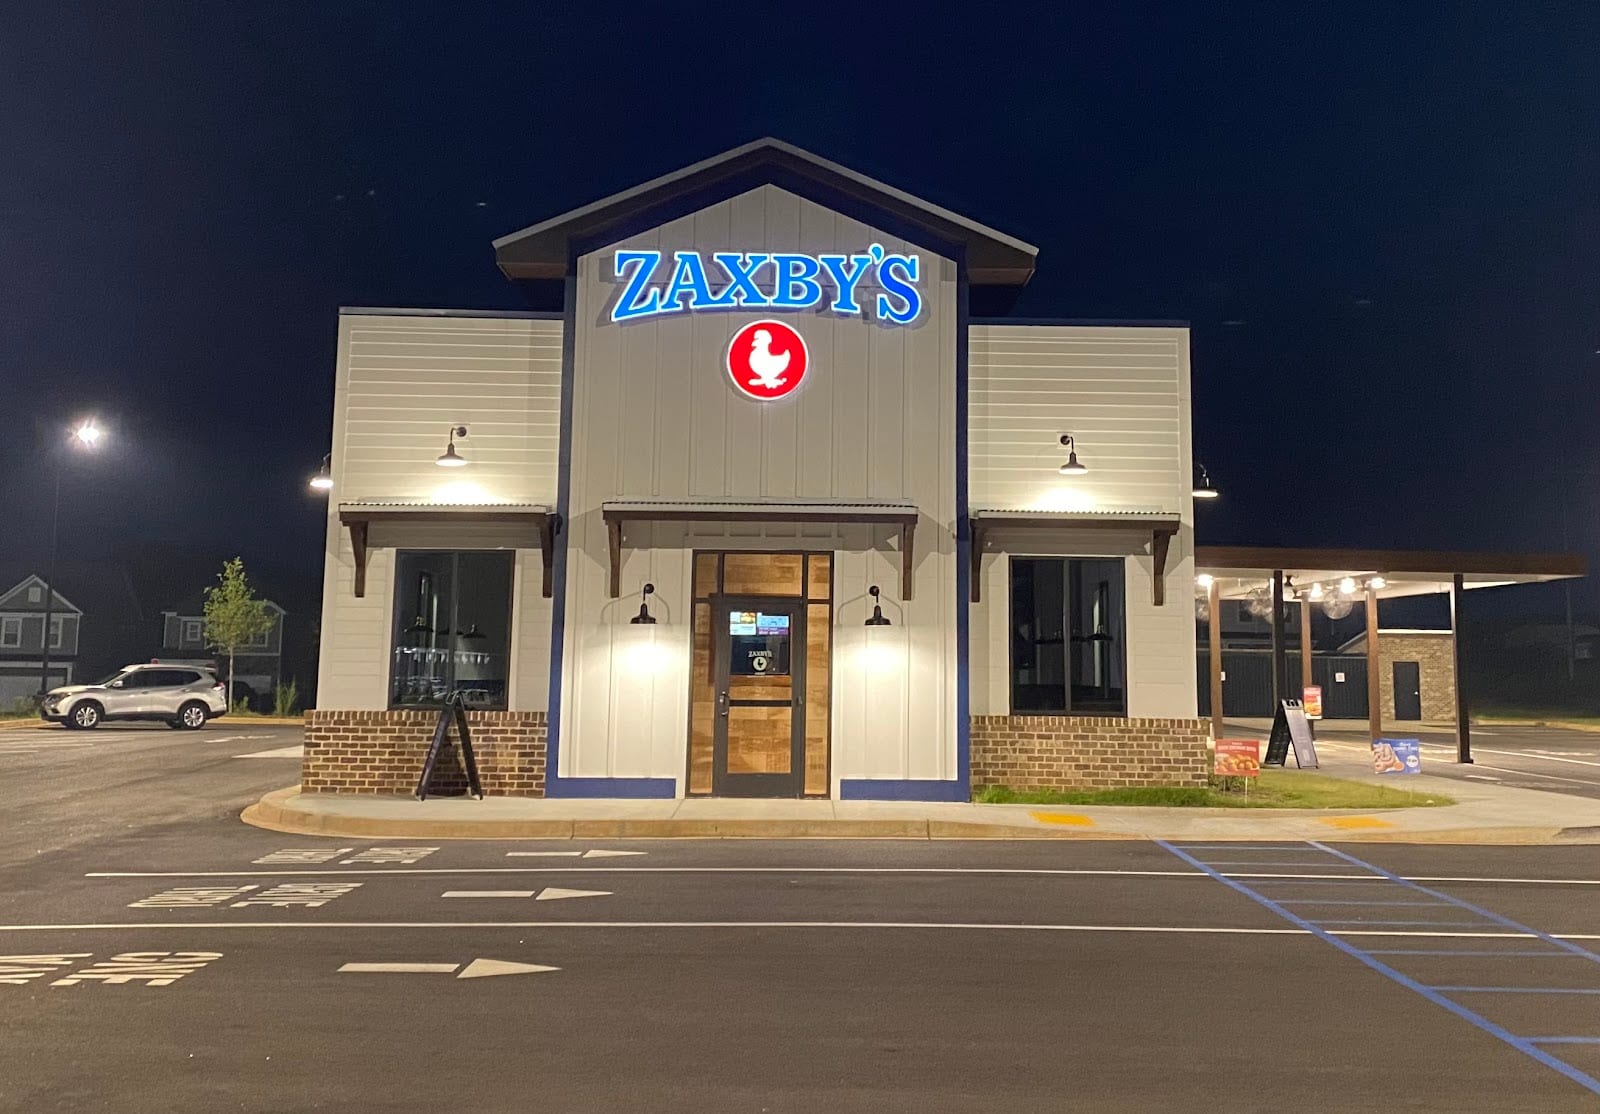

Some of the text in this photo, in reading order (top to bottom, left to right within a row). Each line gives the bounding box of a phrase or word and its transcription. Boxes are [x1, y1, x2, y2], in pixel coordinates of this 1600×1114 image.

[611, 243, 922, 325] ZAXBY'S
[127, 884, 260, 908] THRU
[230, 882, 364, 908] DRIVE
[50, 951, 224, 987] ONE
